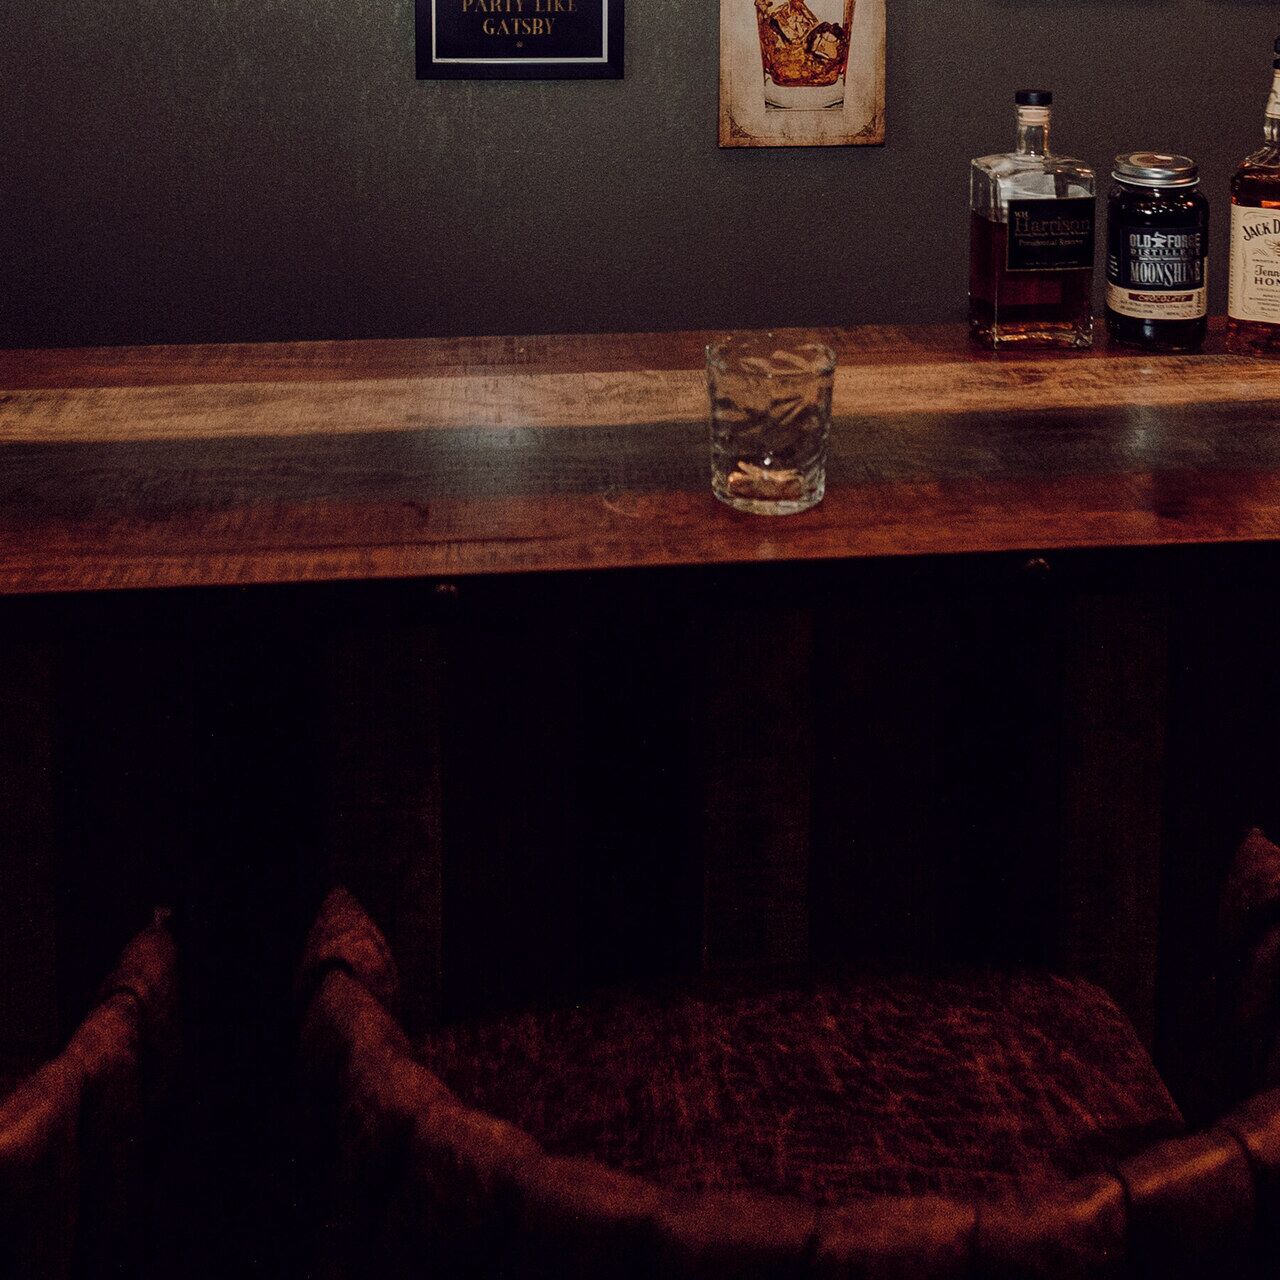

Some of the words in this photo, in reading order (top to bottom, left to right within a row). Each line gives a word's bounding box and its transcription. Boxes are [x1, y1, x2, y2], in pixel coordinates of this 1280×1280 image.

[483, 18, 555, 35] GATSBY
[1242, 221, 1272, 241] JACK
[1129, 233, 1151, 248] OLD
[1130, 261, 1200, 287] MOONSHINE
